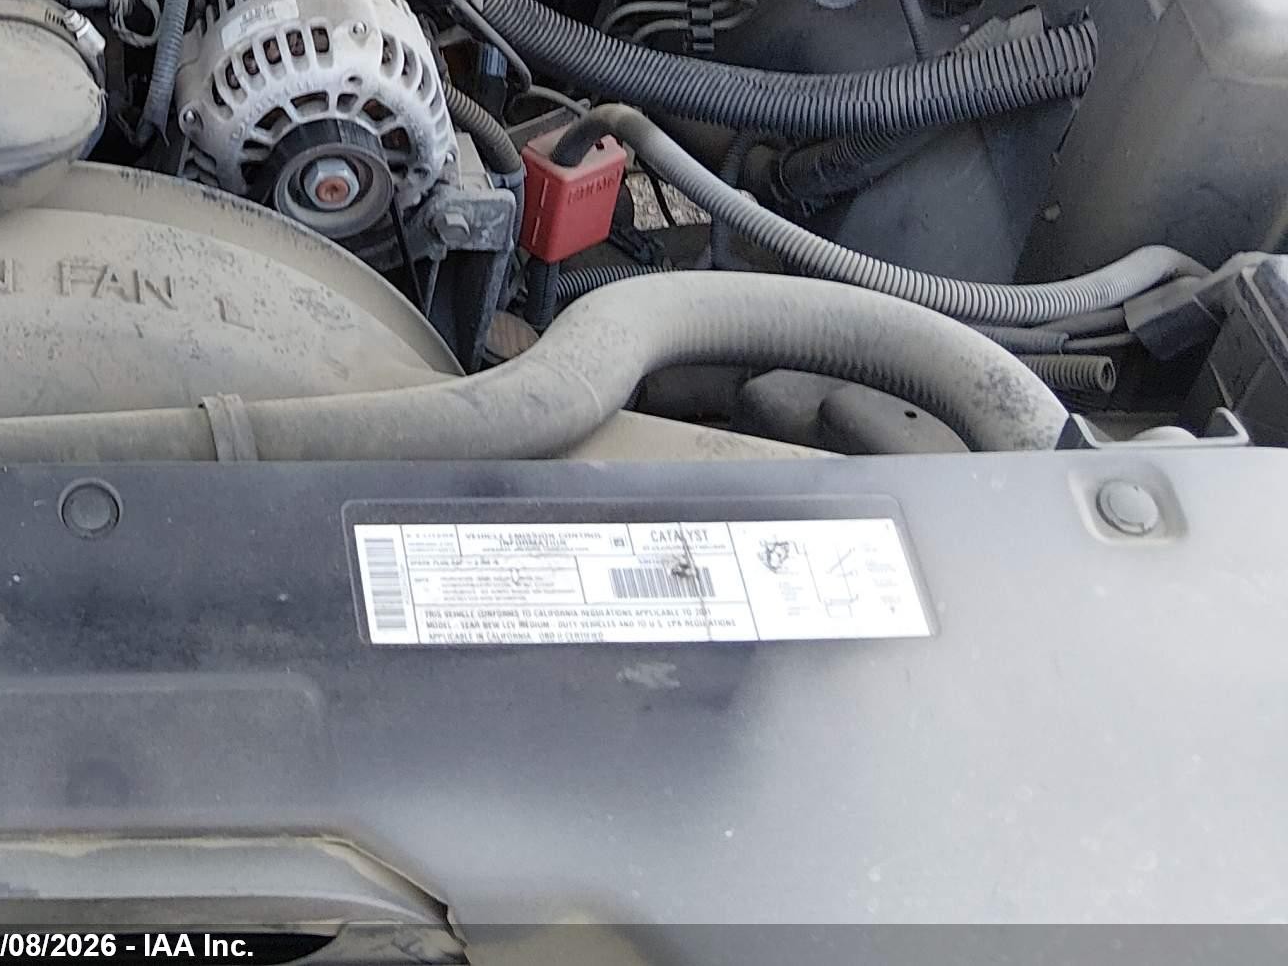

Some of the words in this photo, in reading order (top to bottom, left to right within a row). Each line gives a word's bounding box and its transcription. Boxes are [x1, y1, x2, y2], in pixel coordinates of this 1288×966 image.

[57, 258, 178, 311] FAN
[650, 529, 710, 543] CATALYST
[533, 609, 578, 617] CALIFORNIA
